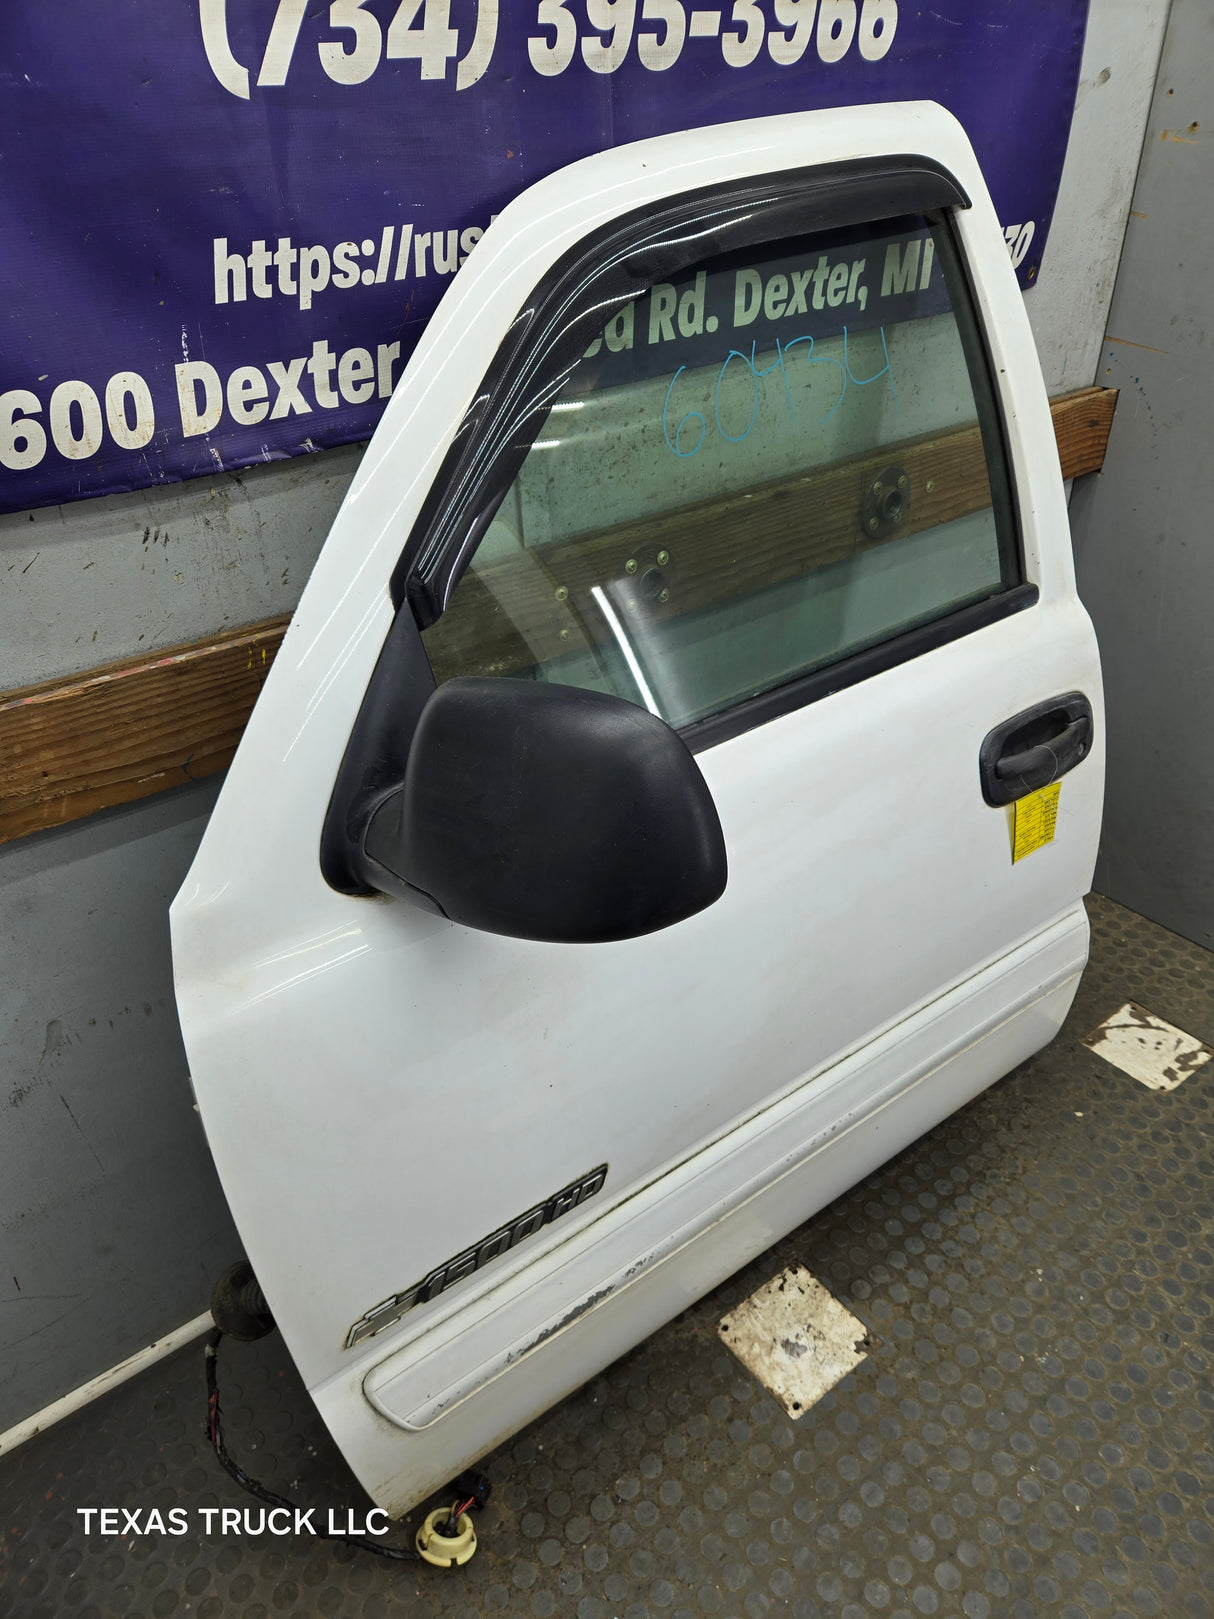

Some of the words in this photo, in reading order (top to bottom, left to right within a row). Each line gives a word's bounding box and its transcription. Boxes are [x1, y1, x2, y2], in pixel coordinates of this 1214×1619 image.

[199, 0, 499, 100] (734)
[527, 0, 899, 77] 395-3966
[174, 340, 401, 439] Dexter
[648, 270, 720, 345] Rd.
[733, 256, 868, 328] Dexter,
[880, 238, 935, 297] MI
[663, 325, 900, 458] 60434
[427, 1209, 545, 1300] 1500
[551, 1173, 605, 1221] HD
